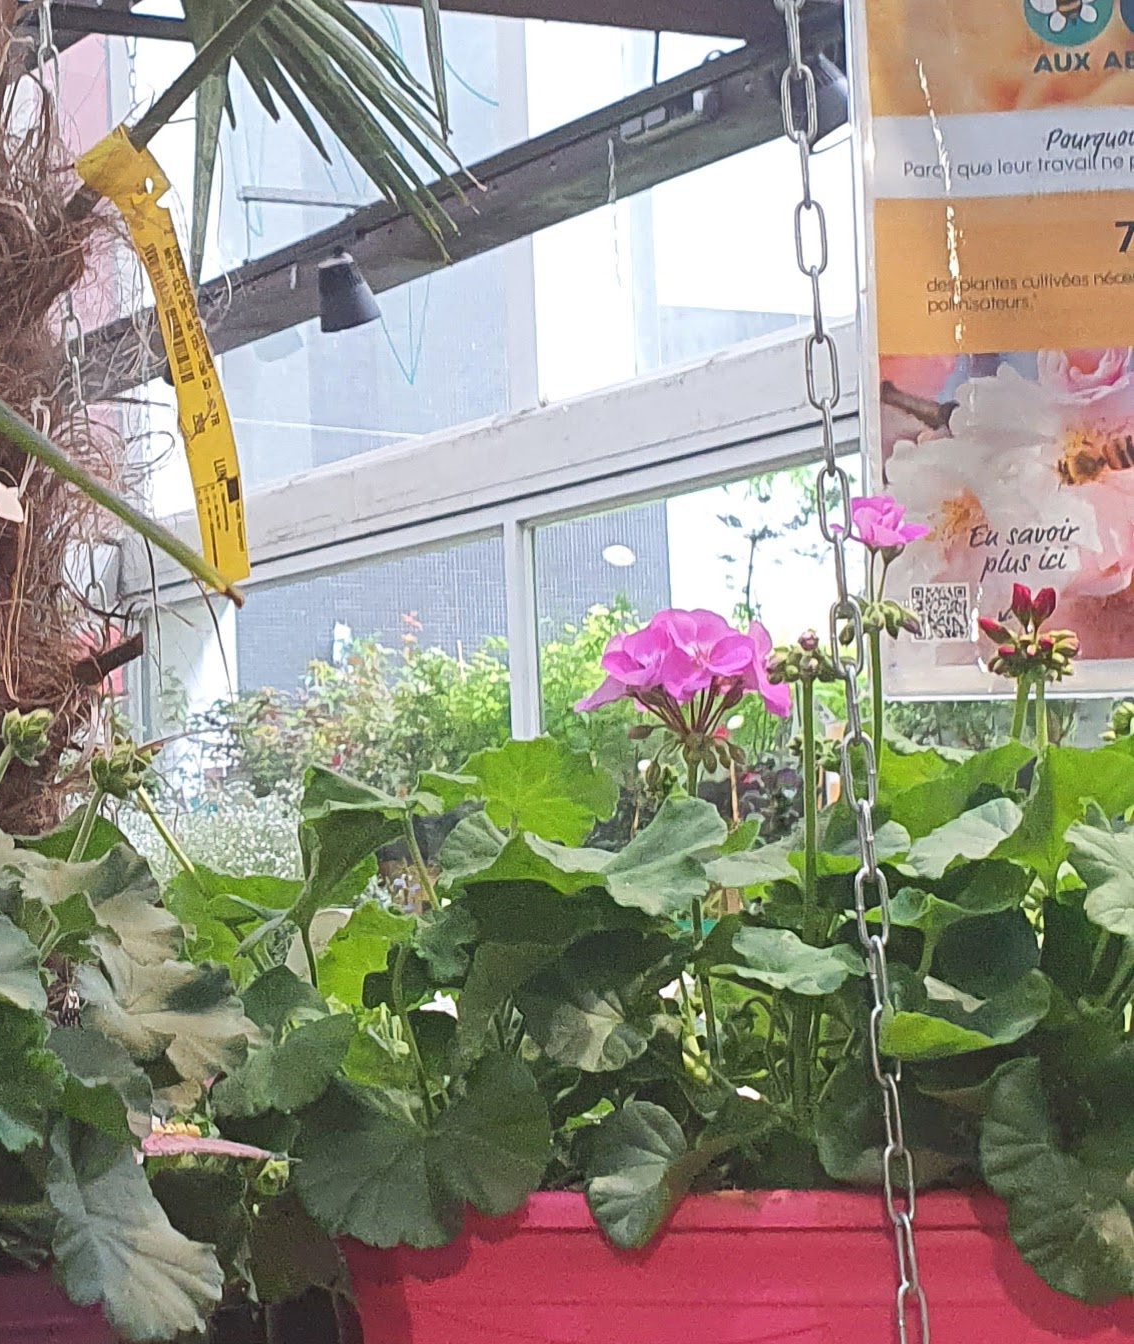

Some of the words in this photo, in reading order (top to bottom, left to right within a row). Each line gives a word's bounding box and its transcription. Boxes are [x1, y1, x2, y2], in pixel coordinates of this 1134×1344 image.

[1033, 52, 1090, 74] AUX
[903, 160, 953, 178] Parc
[957, 160, 992, 180] que
[997, 158, 1032, 175] leur
[1038, 153, 1097, 172] travail
[1101, 155, 1125, 171] ne
[968, 523, 999, 548] En
[1005, 517, 1080, 546] savoir
[979, 548, 1031, 583] plus
[1038, 545, 1069, 571] ici
